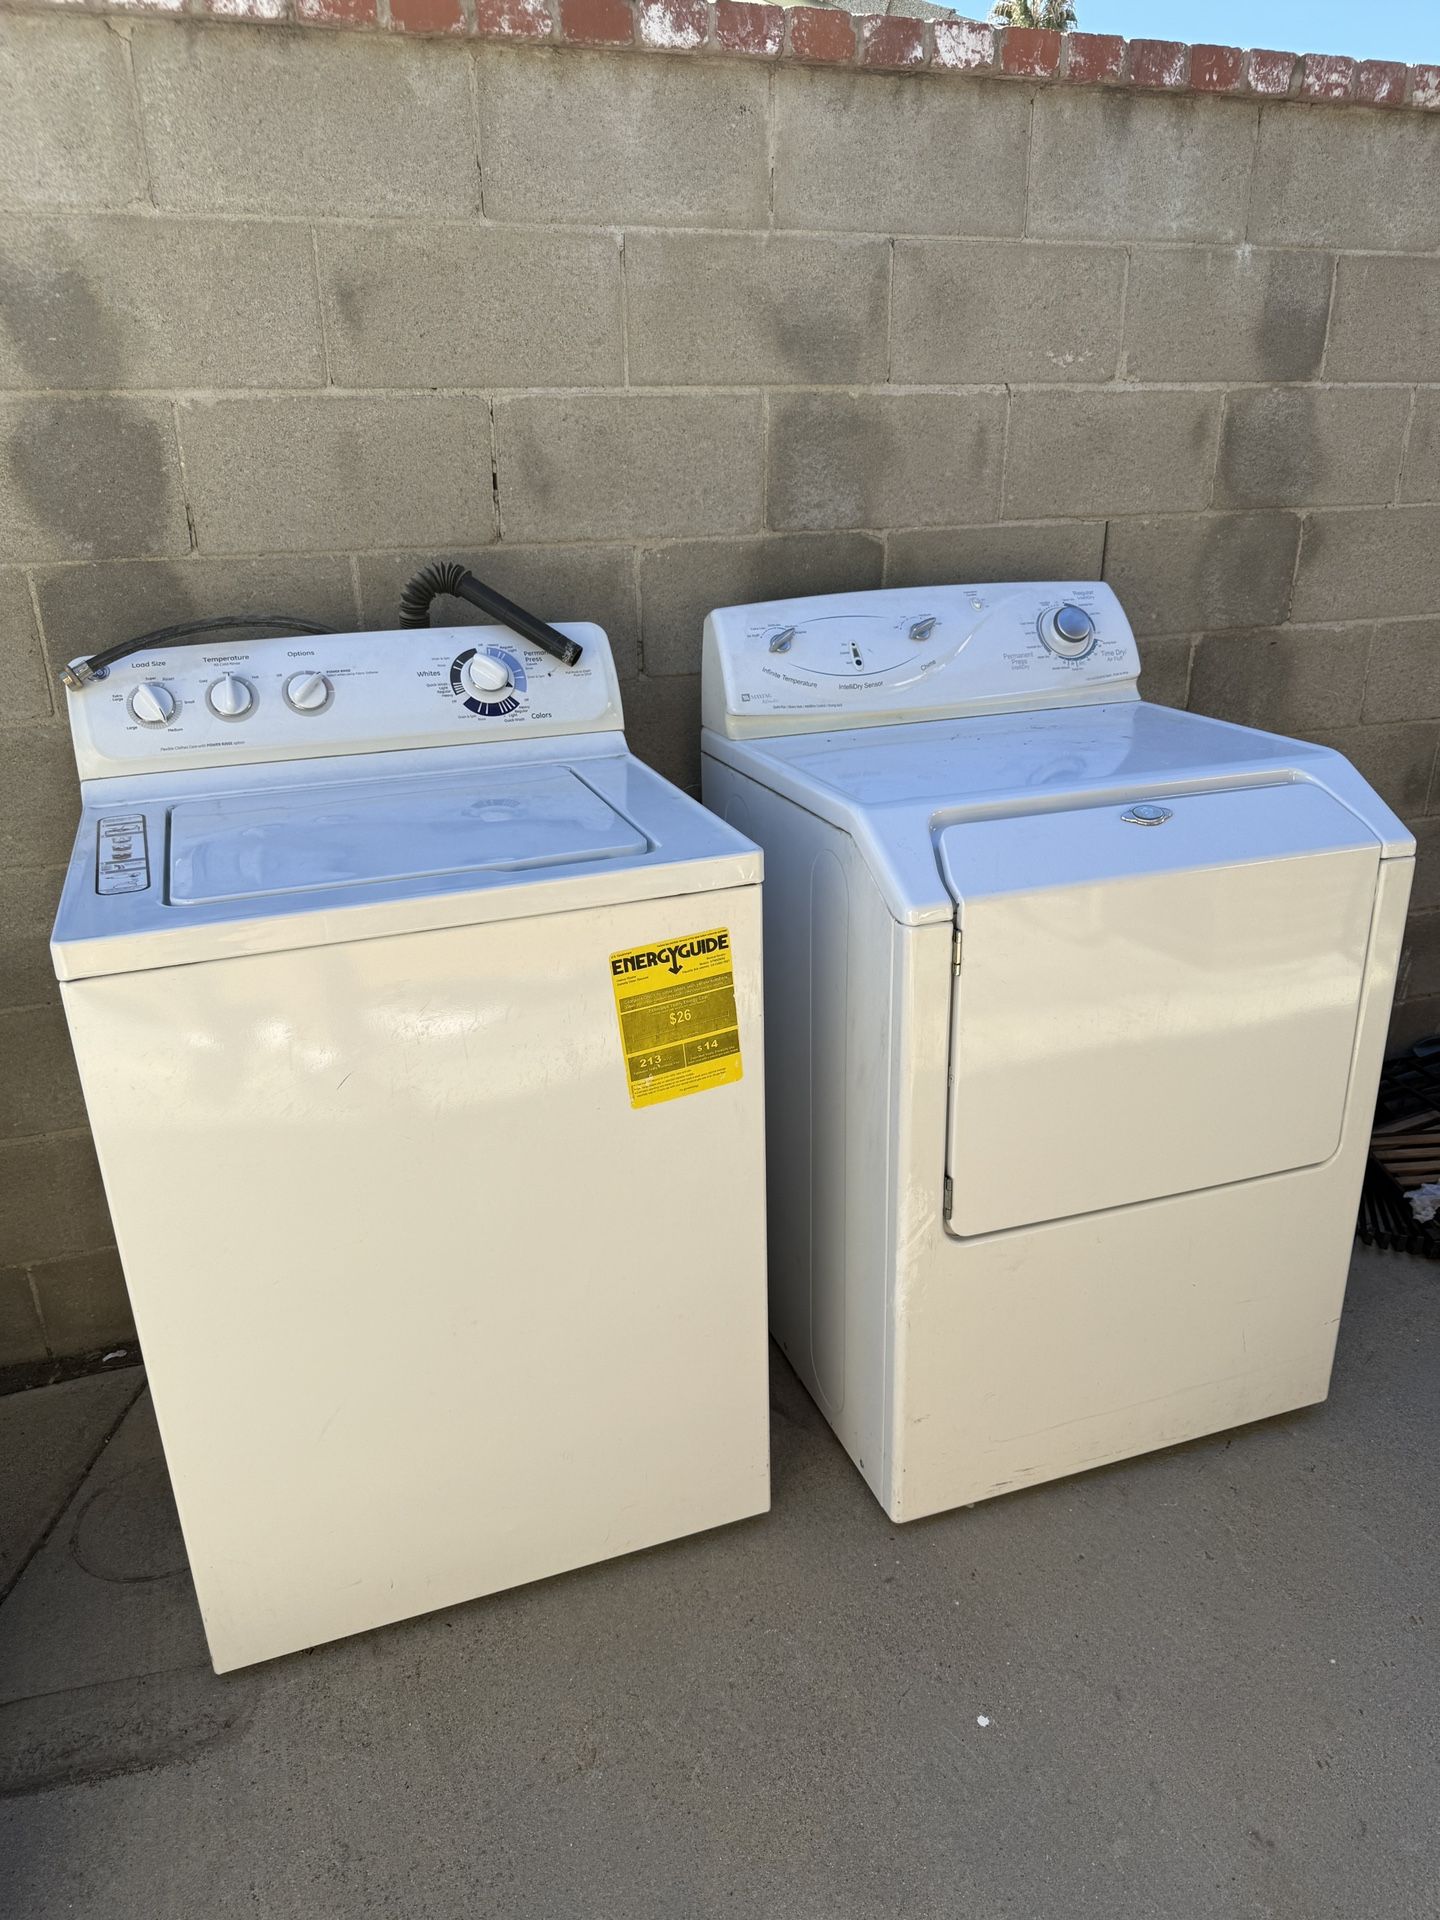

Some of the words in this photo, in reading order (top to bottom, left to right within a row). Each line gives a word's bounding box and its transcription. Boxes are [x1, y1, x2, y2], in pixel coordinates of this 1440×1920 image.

[202, 654, 250, 663] Temperature
[287, 650, 315, 658] Options
[131, 661, 150, 669] Load
[920, 660, 937, 671] Chime
[762, 666, 781, 679] Infinite
[782, 674, 818, 688] Temperature
[531, 712, 552, 720] Colors
[611, 933, 729, 976] ENERGYGUIDE
[669, 1009, 691, 1026] $26
[639, 1055, 662, 1068] 213
